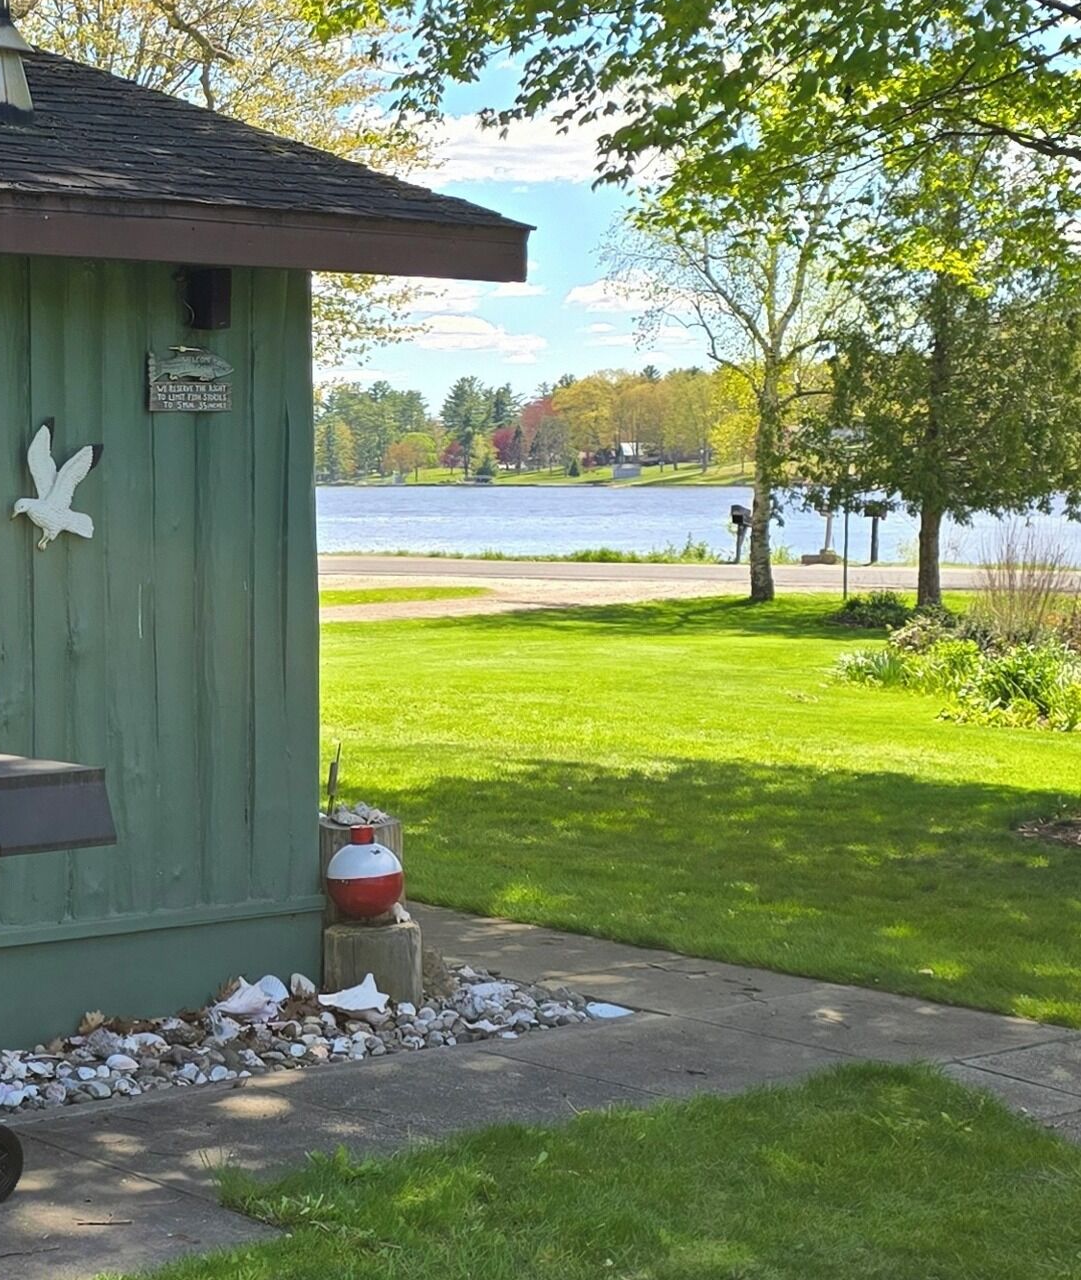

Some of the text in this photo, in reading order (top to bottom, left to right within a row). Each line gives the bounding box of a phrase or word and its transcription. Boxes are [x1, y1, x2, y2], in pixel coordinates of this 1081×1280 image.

[156, 384, 166, 393] WE
[195, 384, 206, 393] THE
[157, 393, 166, 401] TO
[168, 393, 185, 401] LIMIT
[163, 401, 173, 409] TO
